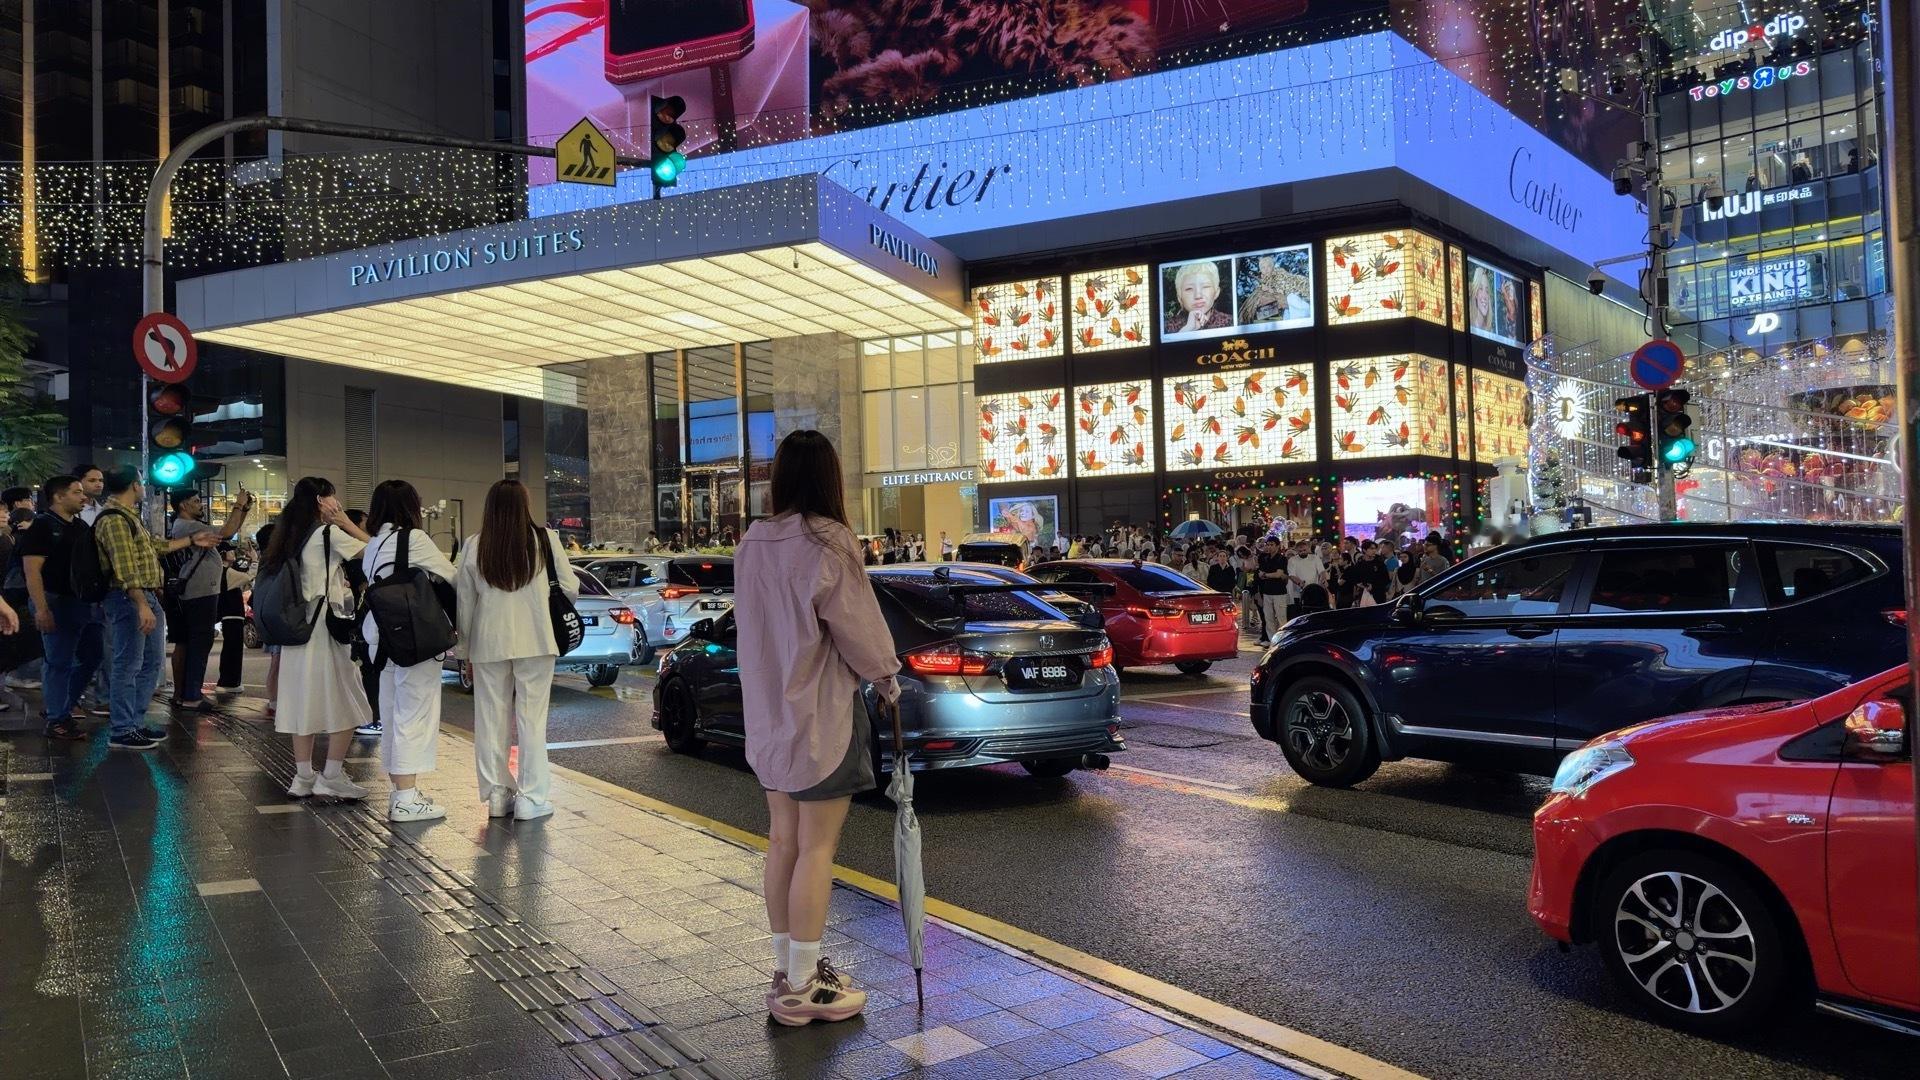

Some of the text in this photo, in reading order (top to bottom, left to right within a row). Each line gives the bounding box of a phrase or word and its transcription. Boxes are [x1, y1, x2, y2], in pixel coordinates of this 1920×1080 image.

[1509, 146, 1582, 232] Cartier
[1763, 187, 1813, 205] 無印良品
[350, 229, 584, 286] PAVILION SUITES
[870, 223, 939, 278] PAVILION
[1731, 268, 1807, 298] KING
[1731, 295, 1747, 305] OF
[1747, 313, 1780, 335] JD
[1196, 347, 1275, 365] COACH
[883, 470, 974, 486] ELITE ENTRANCE
[1214, 469, 1264, 480] COACH
[1021, 666, 1067, 679] VAF 8986
